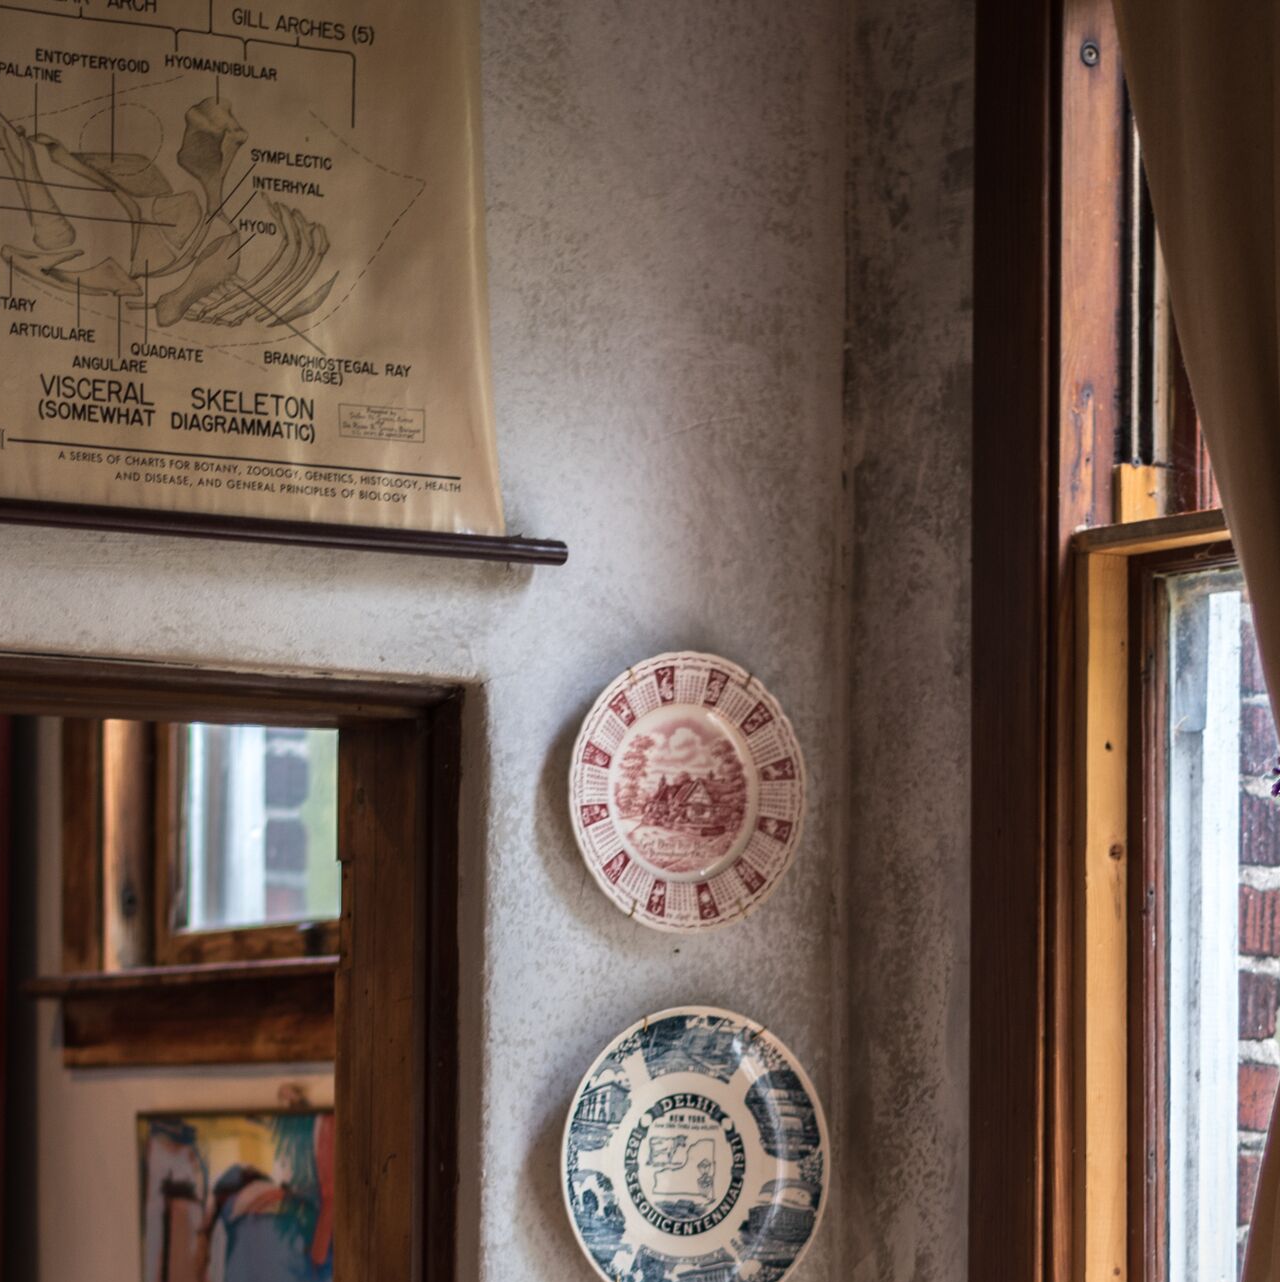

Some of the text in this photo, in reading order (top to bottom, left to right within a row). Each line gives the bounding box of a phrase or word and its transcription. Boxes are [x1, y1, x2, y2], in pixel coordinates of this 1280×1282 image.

[231, 8, 375, 46] GILL ARCHES (5)
[35, 48, 150, 74] ENTOPTERYGOID
[164, 54, 277, 81] HYOMANDIBULAR
[250, 149, 333, 171] SYMPLECTIC
[252, 176, 325, 198] INTERHYAL
[239, 219, 277, 236] HYOID
[9, 323, 96, 343] ARTICULARE
[72, 354, 148, 374] ANGULARE
[130, 342, 204, 364] QUADRATE
[263, 351, 412, 378] BRANCHIOSTEGAL RAY
[301, 369, 343, 387] (BASE)
[39, 373, 315, 420] VISCERAL SKELETON
[37, 401, 156, 427] (SOMEWHAT
[170, 411, 316, 445] DIAGRAMMATIC)
[58, 450, 66, 461] A
[70, 451, 103, 464] SERIES
[106, 453, 120, 465] OF
[124, 455, 165, 468] CHARTS
[170, 458, 190, 471] FOR
[194, 460, 241, 476] BOTANY,
[305, 470, 357, 485] GENETICS,
[360, 475, 421, 490] HISTOLOGY,
[424, 480, 461, 493] HEALTH
[115, 471, 408, 503] AND DISEASE, AND GENERAL PRINCIPLES OF BIOLOGY
[661, 1094, 716, 1114] DELHI
[625, 1172, 742, 1234] SESQUICENTENNIAL
